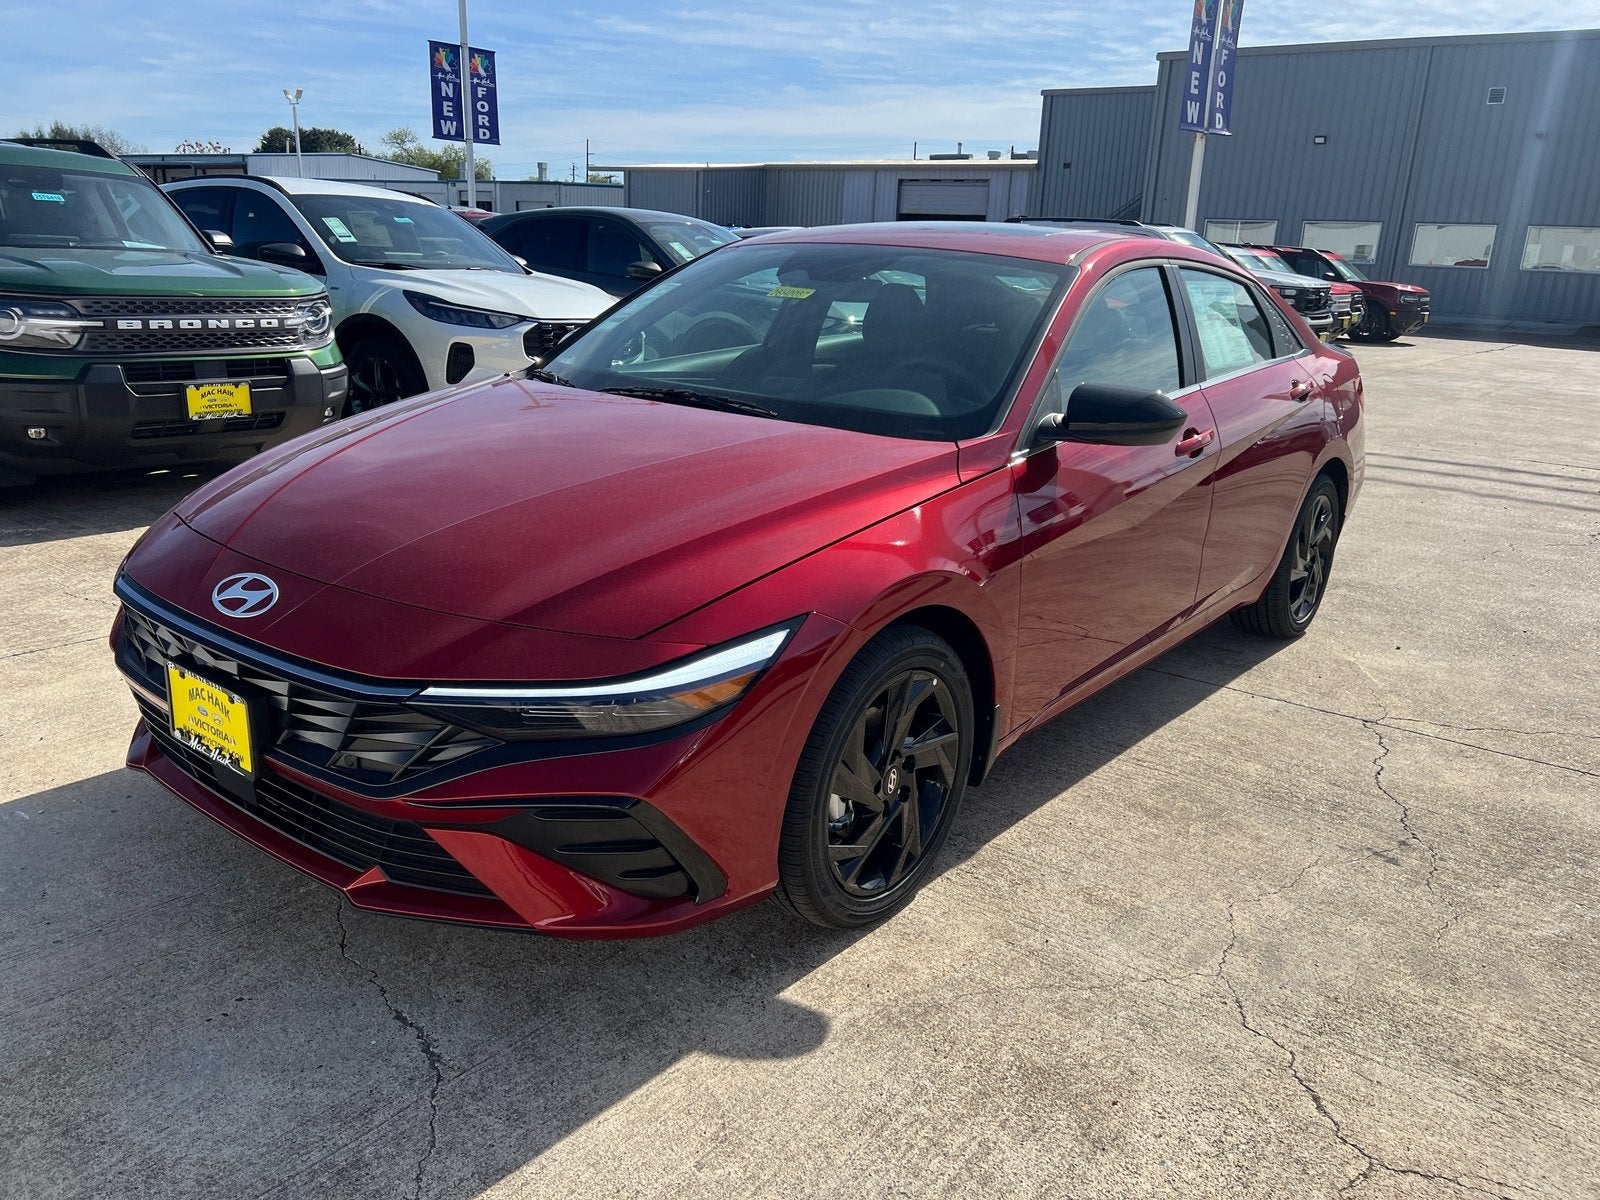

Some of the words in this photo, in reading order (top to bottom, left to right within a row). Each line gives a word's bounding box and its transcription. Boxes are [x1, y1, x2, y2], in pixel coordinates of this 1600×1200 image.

[1186, 40, 1204, 124] NEW
[1215, 48, 1229, 129] FORD
[440, 81, 457, 136] NEW
[476, 86, 491, 140] FORD
[117, 319, 279, 330] BRONCO
[200, 389, 216, 399] MAC
[217, 388, 234, 397] HAIK
[188, 687, 206, 702] MAC
[207, 690, 231, 722] HAIK
[193, 715, 231, 743] VICTORIA
